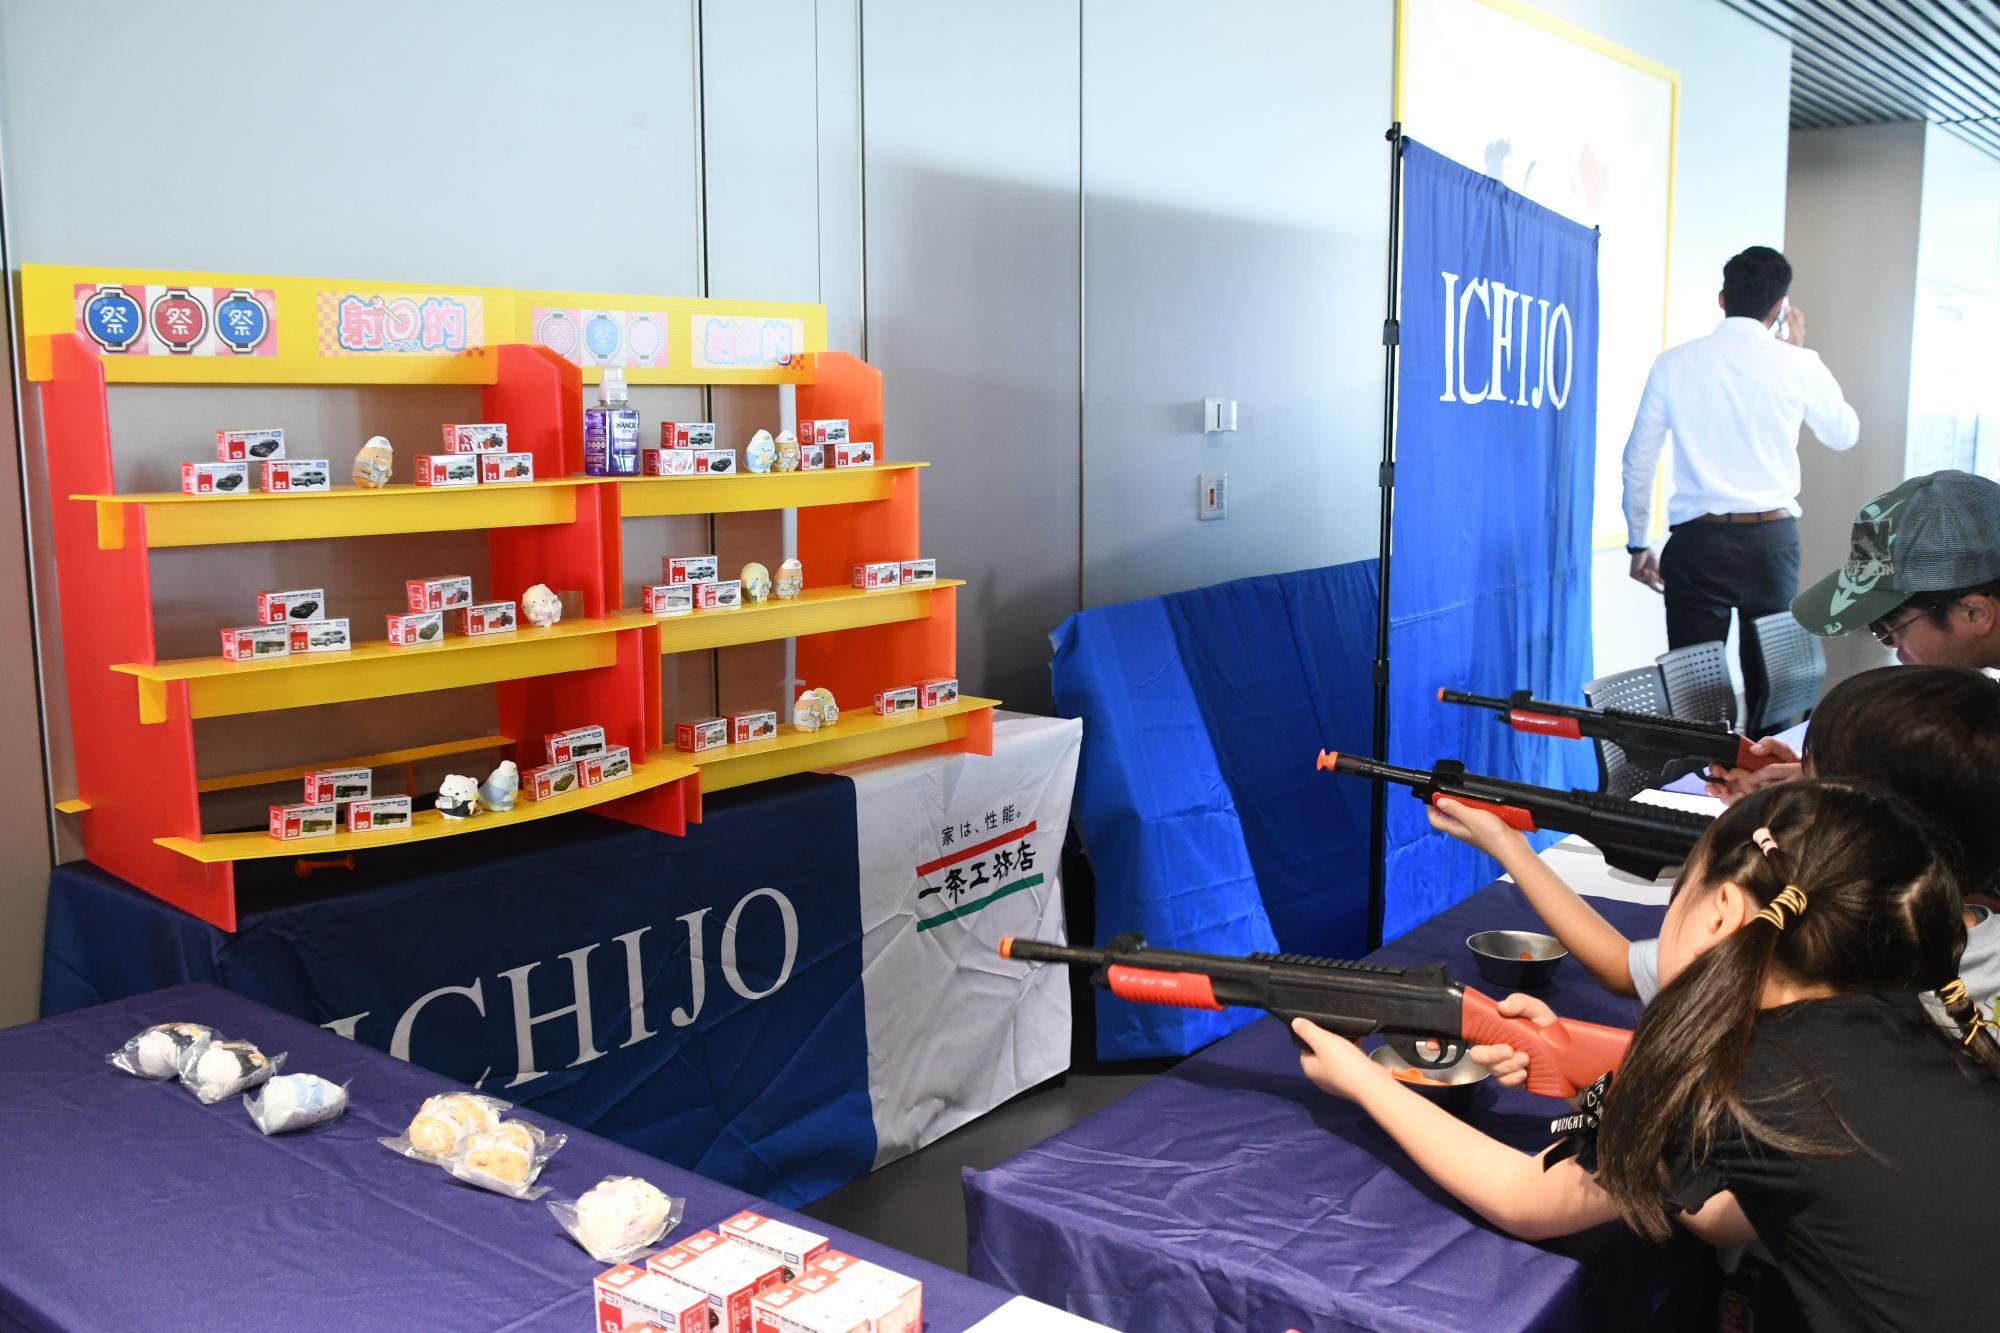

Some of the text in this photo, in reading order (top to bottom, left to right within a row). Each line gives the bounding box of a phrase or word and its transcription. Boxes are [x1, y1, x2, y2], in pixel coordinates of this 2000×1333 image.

[100, 306, 253, 337] 祭 祭 祭
[1440, 271, 1573, 411] ICHIJO
[488, 472, 497, 480] 71
[275, 481, 287, 489] 21
[558, 754, 569, 763] 20
[591, 776, 600, 785] 21
[320, 794, 332, 802] 20
[356, 821, 369, 829] 20
[941, 804, 1021, 847] 家は、性能。
[1557, 1114, 1584, 1132] BRIGHT
